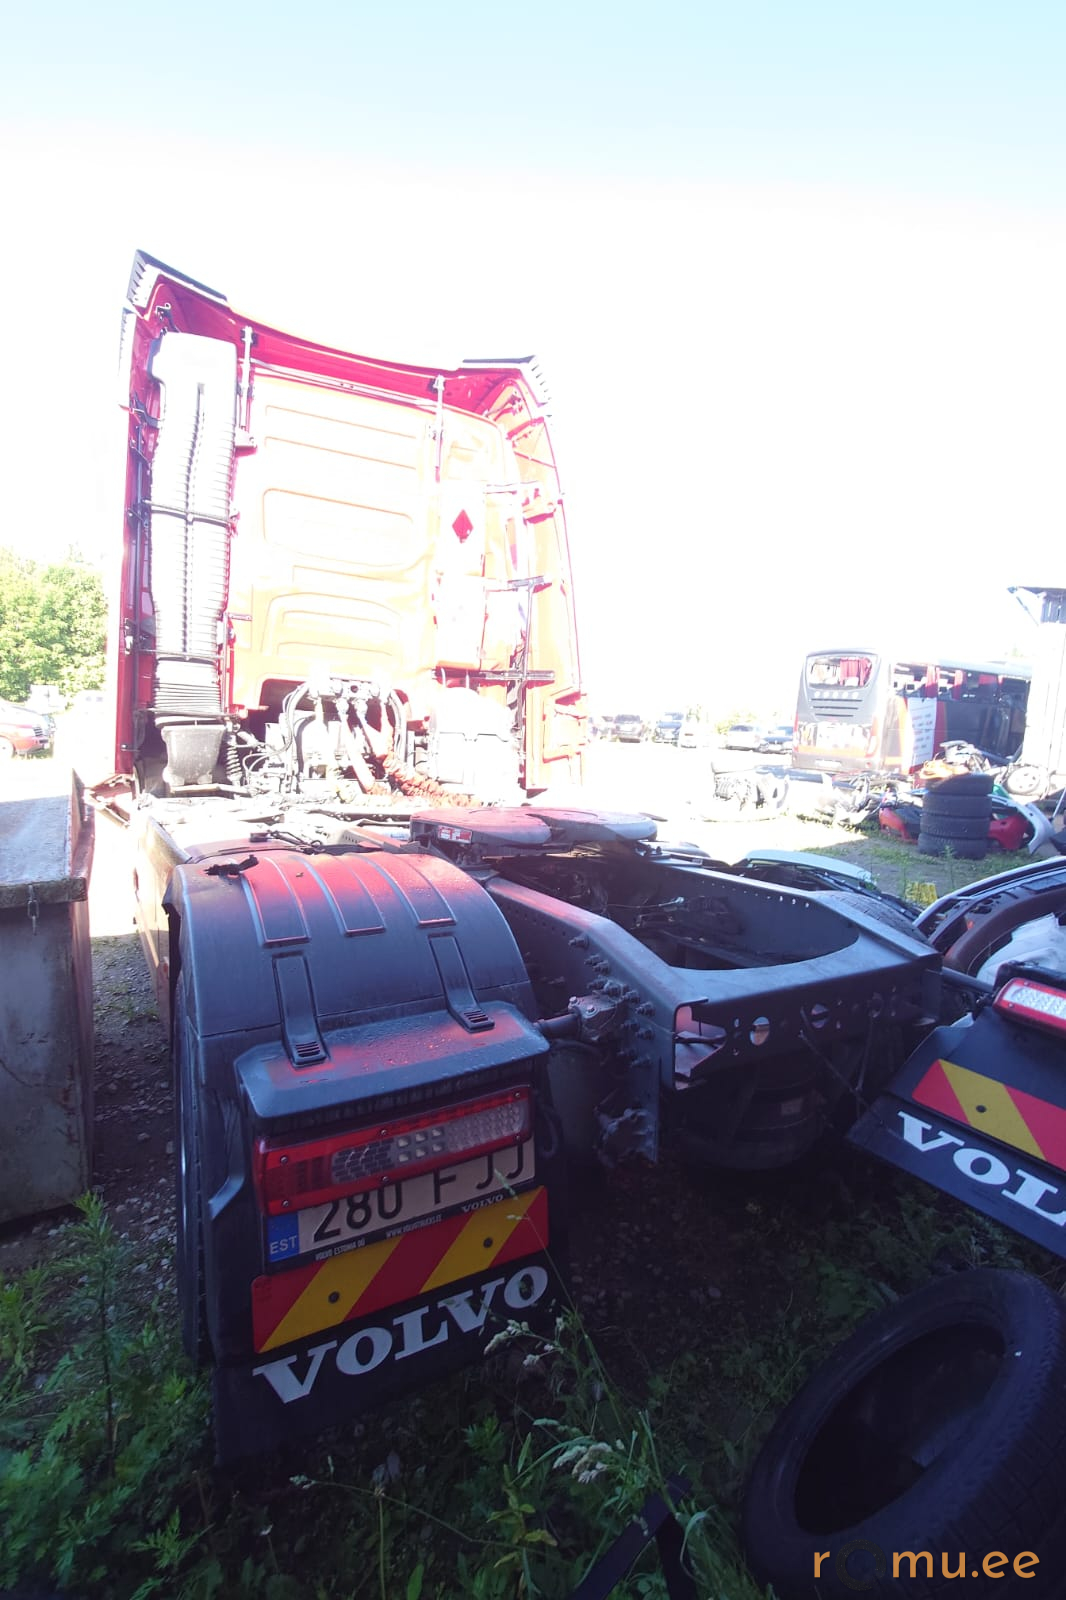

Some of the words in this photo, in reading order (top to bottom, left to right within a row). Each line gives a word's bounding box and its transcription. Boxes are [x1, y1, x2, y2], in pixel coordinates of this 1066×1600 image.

[898, 1111, 1066, 1226] VOL
[462, 1194, 504, 1213] VOLVO
[270, 1235, 298, 1255] EST
[252, 1266, 549, 1404] VOLVO
